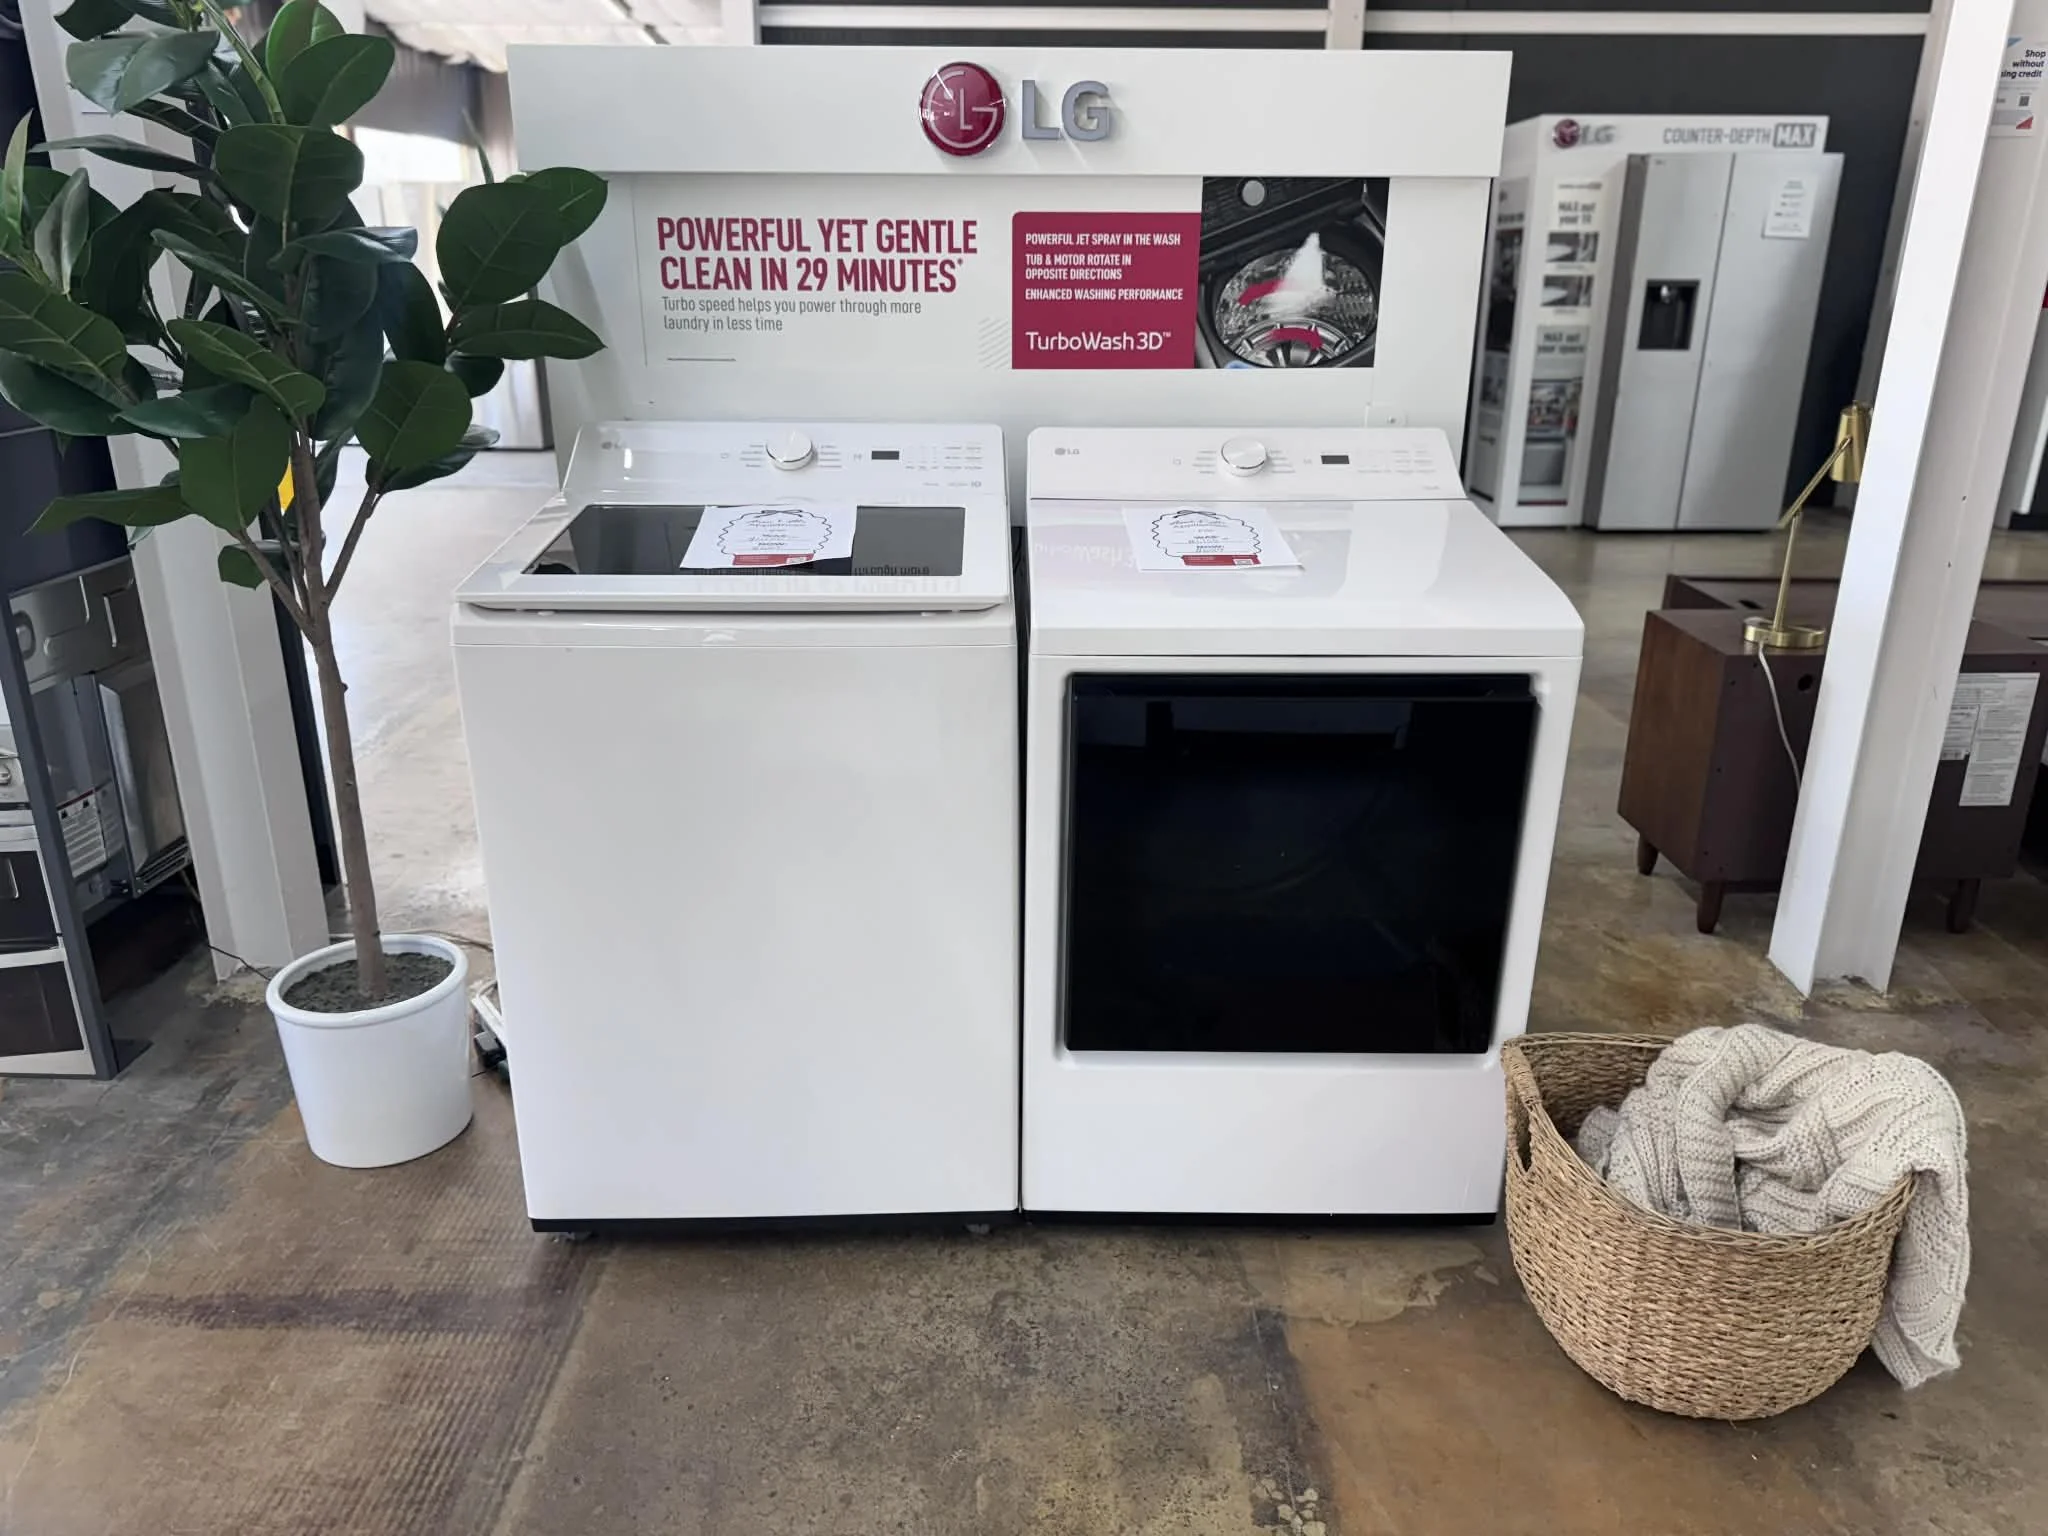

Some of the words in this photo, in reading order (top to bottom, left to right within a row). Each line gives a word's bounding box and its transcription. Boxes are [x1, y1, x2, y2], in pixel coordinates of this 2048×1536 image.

[2024, 49, 2047, 59] Shop
[2012, 60, 2045, 68] without
[2001, 69, 2017, 79] sing
[2018, 69, 2042, 78] credit
[1021, 79, 1112, 142] LG
[1663, 128, 1771, 144] COUNTER-DEPTH
[1775, 124, 1816, 146] MAX
[657, 217, 811, 253] POWERFUL
[818, 219, 868, 253] YET
[876, 219, 978, 254] GENTLE
[1025, 233, 1074, 245] POWERFUL
[1076, 234, 1090, 245] JET
[1091, 234, 1121, 245] SPRAY
[1123, 234, 1133, 245] IN
[1135, 234, 1151, 245] THE
[1152, 234, 1181, 246] WASH
[1025, 254, 1043, 265] TUB
[1045, 254, 1052, 265] &
[1054, 254, 1085, 265] MOTOR
[1087, 254, 1120, 265] ROTATE
[1122, 254, 1132, 265] IN
[660, 256, 752, 290] CLEAN
[761, 258, 788, 291] IN
[797, 258, 828, 292] 29
[1025, 269, 1068, 280] OPPOSITE
[1070, 269, 1122, 280] DIRECTIONS
[1025, 289, 1073, 300] ENHANCED
[1074, 289, 1116, 300] WASHING
[1118, 289, 1183, 301] PERFORMANCE
[661, 296, 696, 312] Turbo
[698, 297, 735, 314] speed
[738, 298, 772, 315] helps
[774, 301, 796, 315] you
[799, 301, 836, 315] power
[839, 299, 887, 316] through
[890, 302, 922, 314] more
[663, 315, 710, 333] laundry
[713, 316, 724, 331] in
[726, 316, 753, 331] less
[755, 317, 783, 331] time
